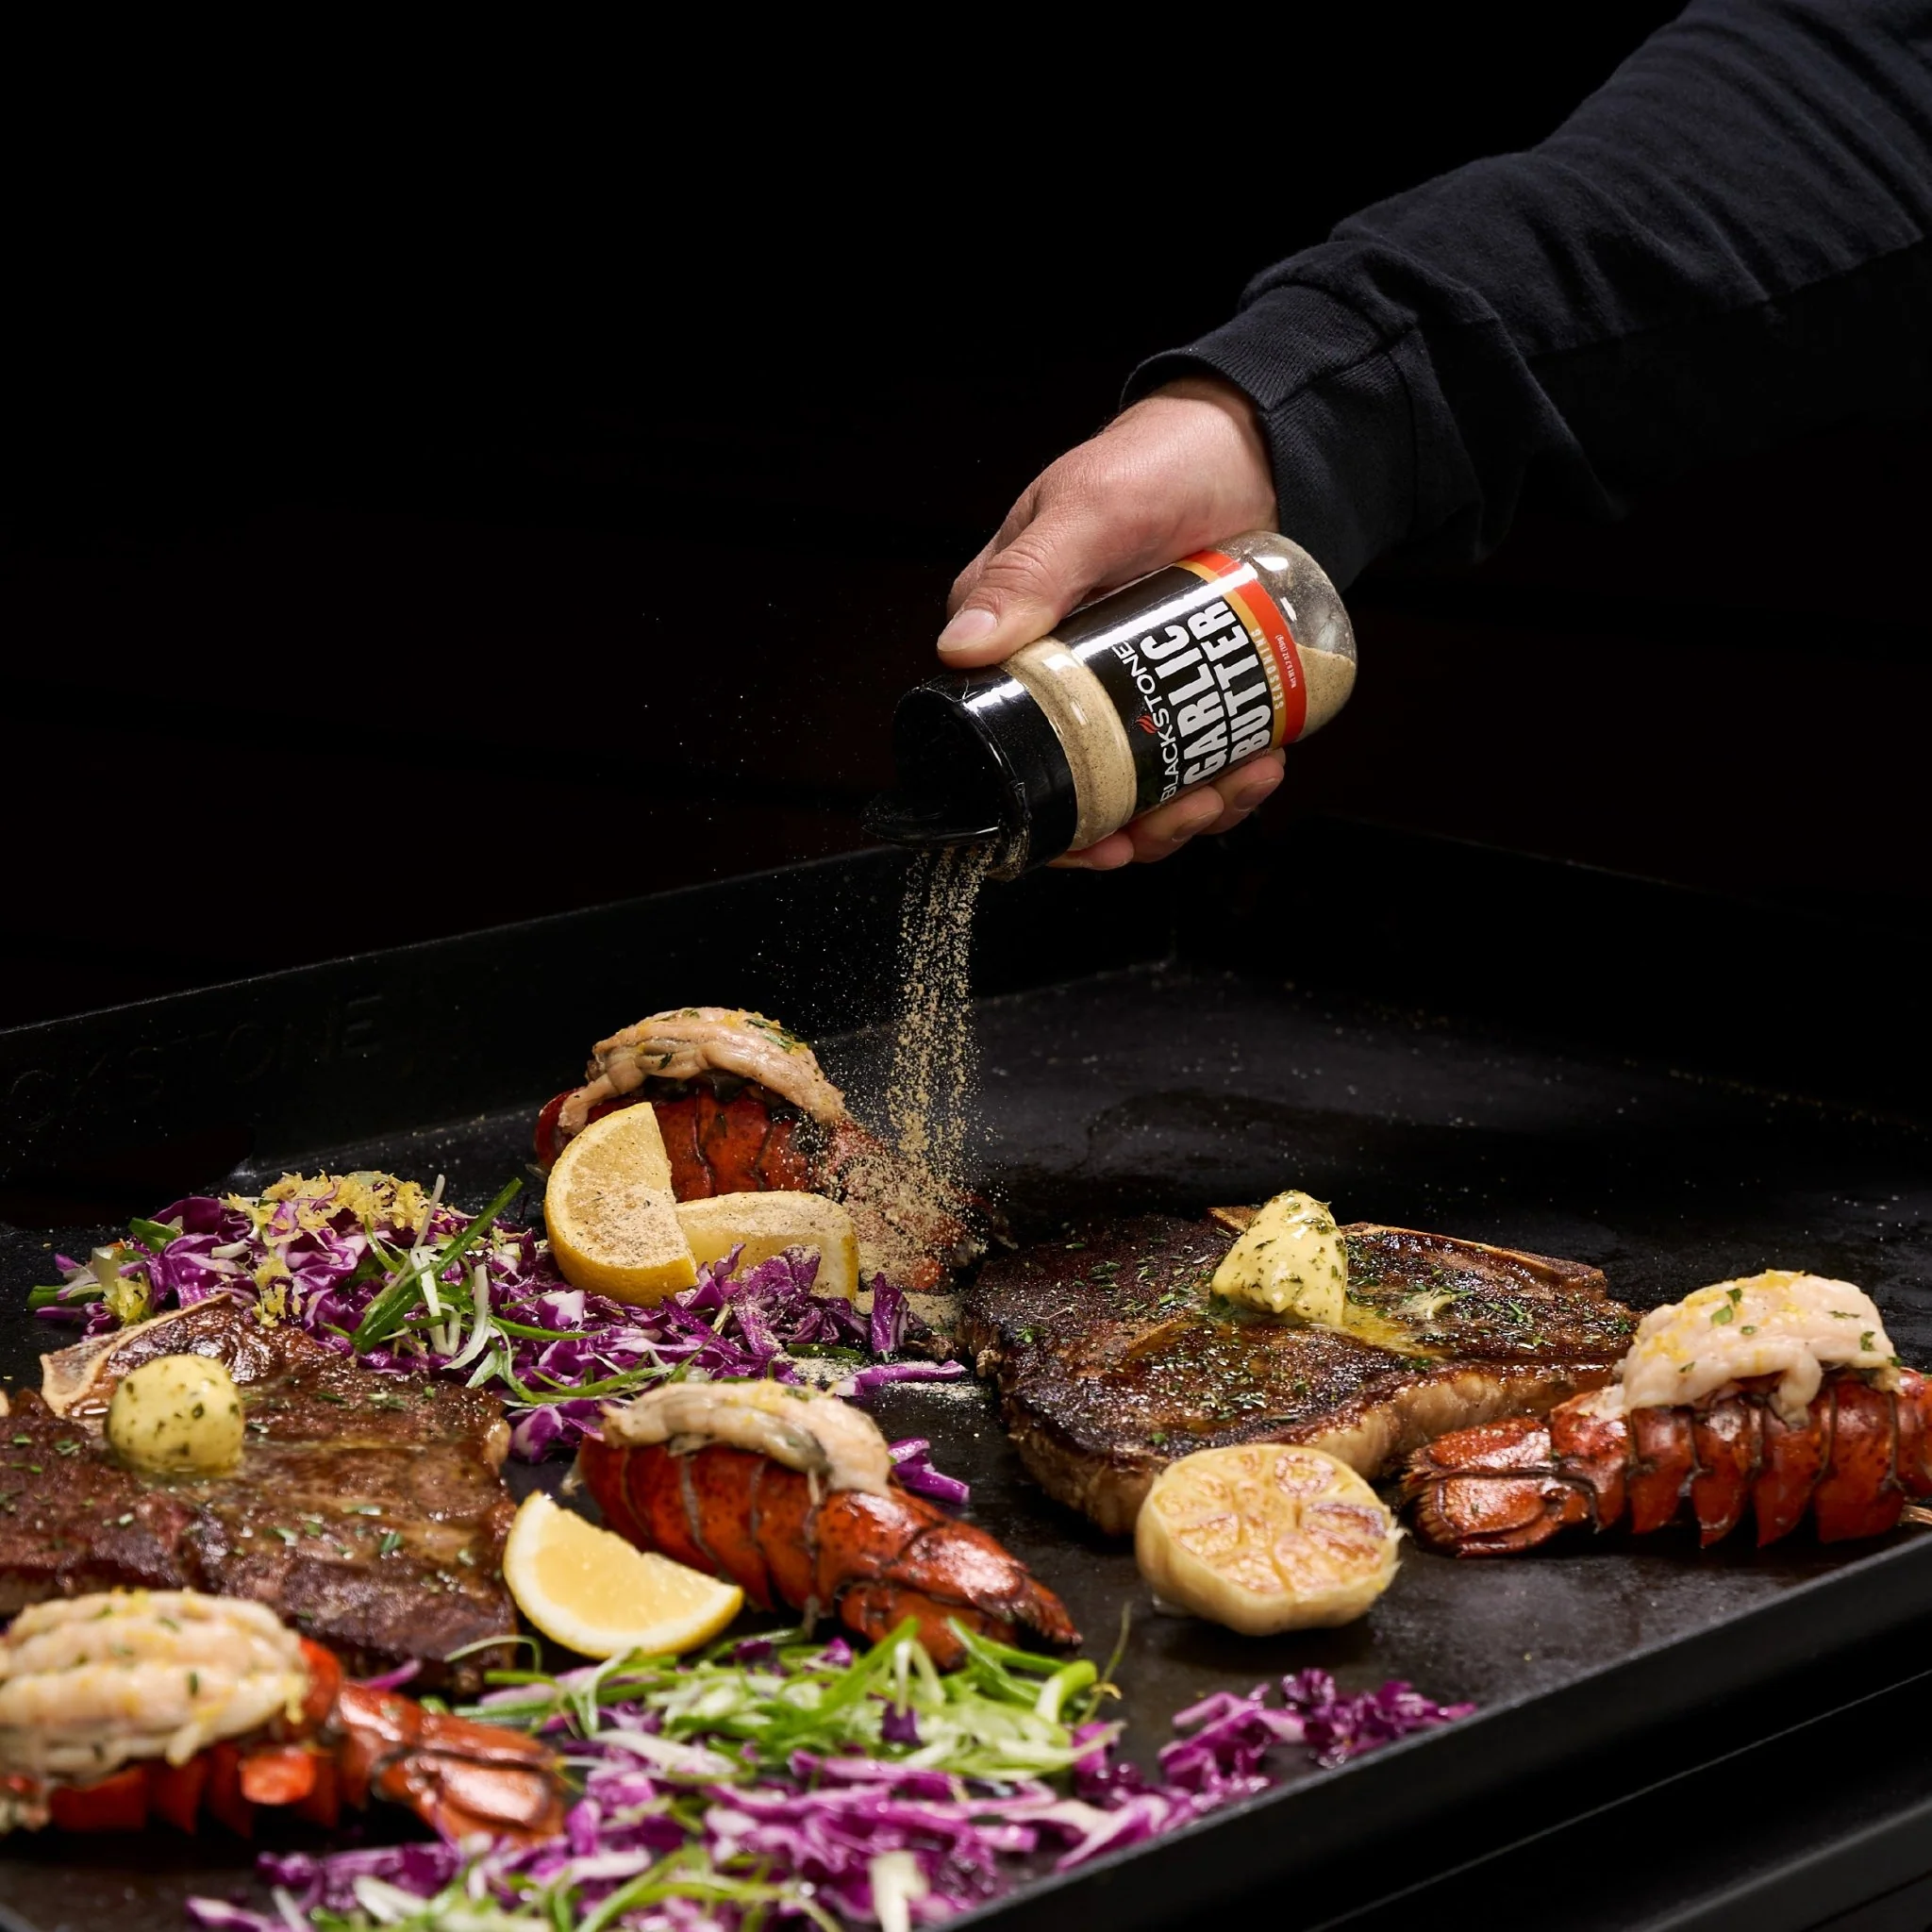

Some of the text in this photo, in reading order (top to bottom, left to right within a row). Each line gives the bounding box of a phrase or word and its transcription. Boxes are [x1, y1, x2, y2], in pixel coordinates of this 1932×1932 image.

[1112, 641, 1179, 802] BLACKSTONE
[1140, 625, 1228, 785] GARLIC
[1187, 601, 1272, 764] BUTTER
[1250, 628, 1284, 709] SEASONING
